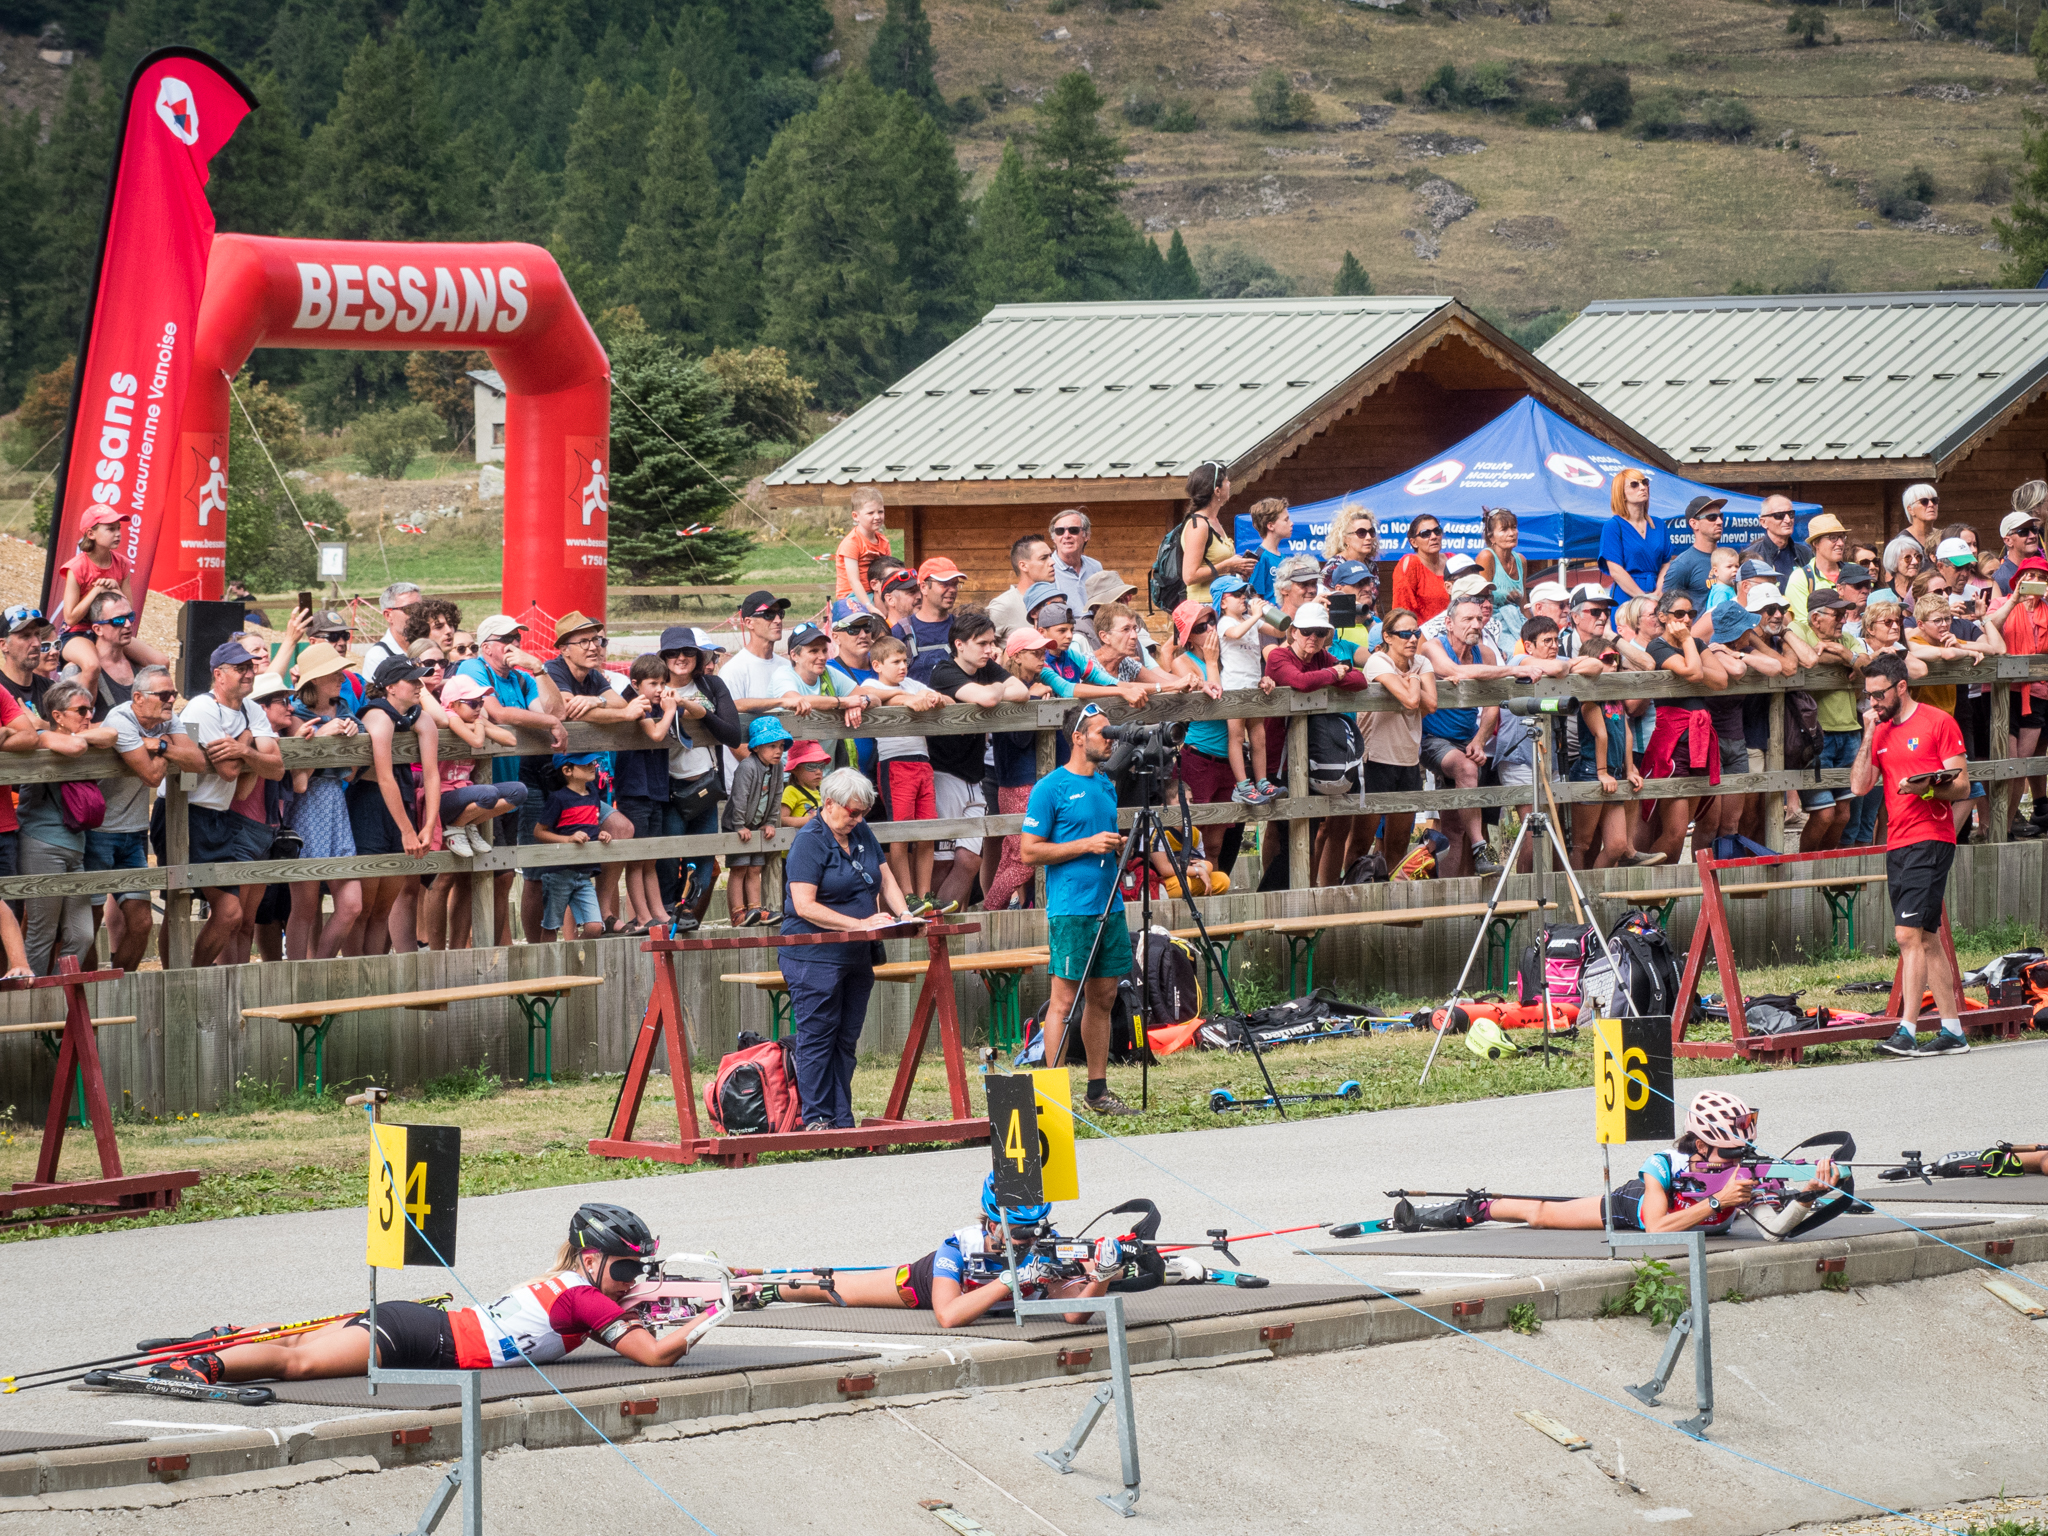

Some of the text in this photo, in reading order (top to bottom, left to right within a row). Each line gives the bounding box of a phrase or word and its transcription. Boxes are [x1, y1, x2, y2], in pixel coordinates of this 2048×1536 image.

[292, 262, 528, 333] BESSANS
[91, 371, 138, 506] ssans
[127, 321, 177, 573] aute Maurienne Vanoise
[1473, 461, 1513, 471] Haute
[1459, 479, 1510, 488] Vanoise
[1465, 470, 1535, 480] Maurienne
[1309, 539, 1326, 551] Ce
[1379, 538, 1399, 550] ans
[1441, 537, 1465, 550] eval
[1669, 533, 1696, 544] ssans
[196, 557, 220, 568] 1750
[581, 554, 603, 566] 1750
[1604, 1051, 1615, 1112] 5
[1623, 1047, 1650, 1111] 6
[1005, 1108, 1026, 1173] 4
[379, 1160, 394, 1232] 3
[405, 1162, 431, 1231] 4
[544, 1279, 563, 1296] ENNE
[145, 1383, 168, 1393] Enjoy
